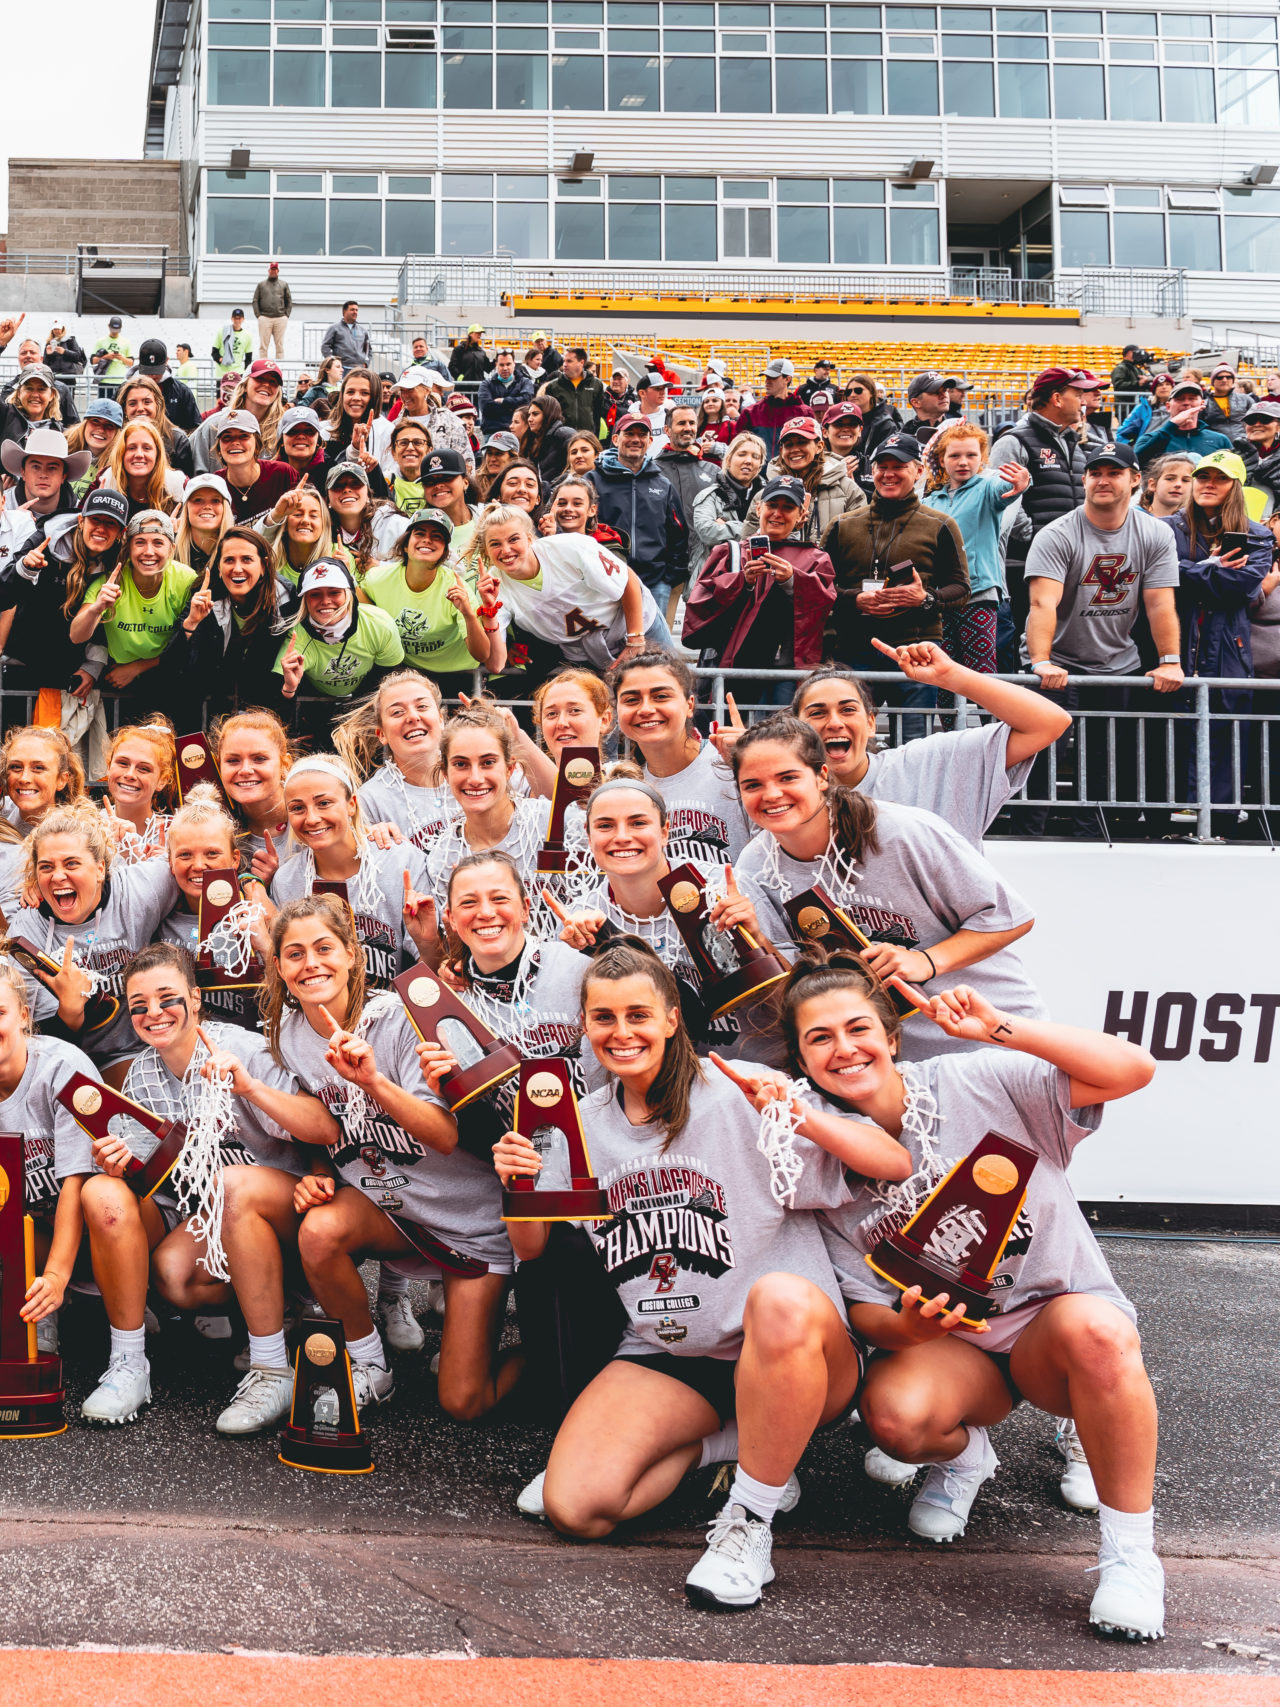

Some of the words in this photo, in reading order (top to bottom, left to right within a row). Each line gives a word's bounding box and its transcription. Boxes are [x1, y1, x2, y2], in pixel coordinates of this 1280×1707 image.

[674, 396, 702, 405] SECTION
[92, 496, 125, 512] GRATEFUL
[598, 551, 620, 577] 4
[564, 607, 607, 637] 4
[1079, 608, 1132, 617] LACROSSE
[567, 771, 593, 779] NCAA
[354, 913, 398, 951] CROSSE
[848, 904, 920, 942] CROSSE
[523, 1022, 583, 1050] LACROS
[1103, 990, 1280, 1063] HOST
[530, 1088, 561, 1099] NCAA
[630, 1192, 686, 1212] NATIONAL
[650, 1167, 728, 1218] LACROSSE
[595, 1207, 737, 1273] CHAMPIONS
[641, 1300, 665, 1312] BOSTON
[667, 1298, 695, 1310] COLLEGE
